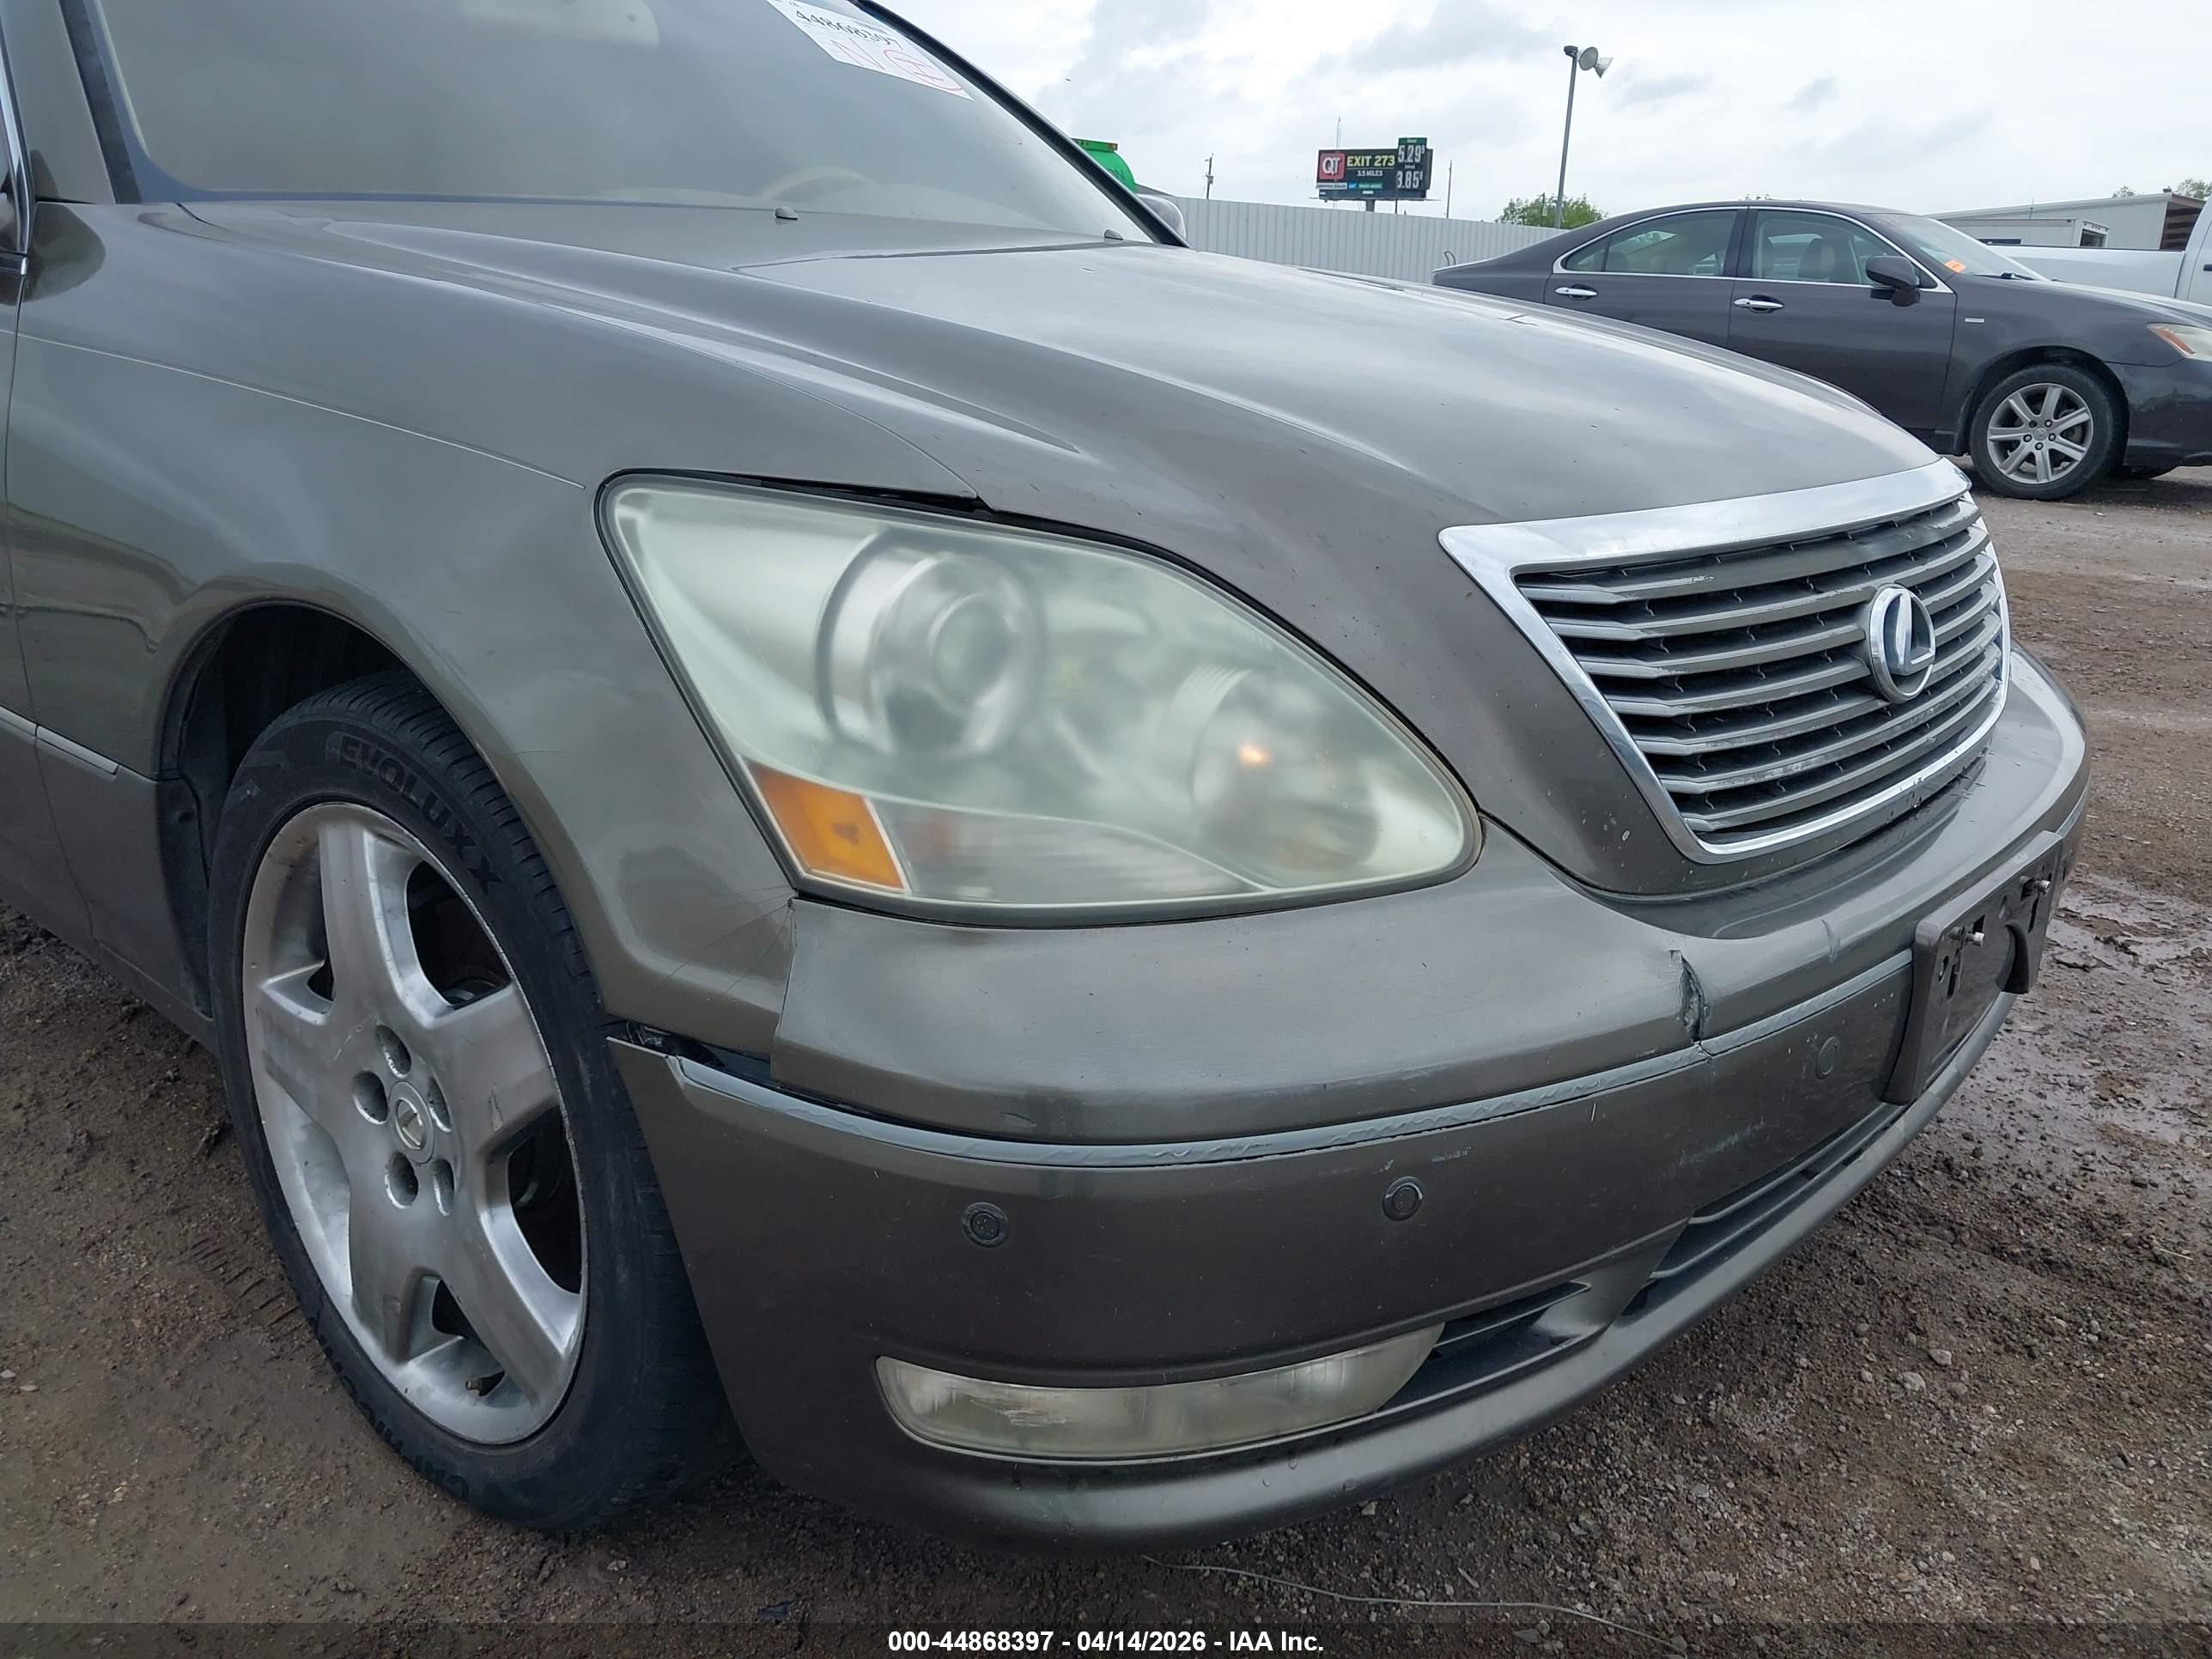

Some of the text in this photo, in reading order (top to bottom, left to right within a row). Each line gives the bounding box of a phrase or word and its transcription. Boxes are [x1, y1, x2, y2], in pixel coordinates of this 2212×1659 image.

[796, 10, 903, 51] 44868397
[1322, 156, 1341, 176] QT
[1346, 155, 1372, 167] EXIT
[1374, 155, 1396, 167] 273
[339, 734, 503, 896] EVOLUXX
